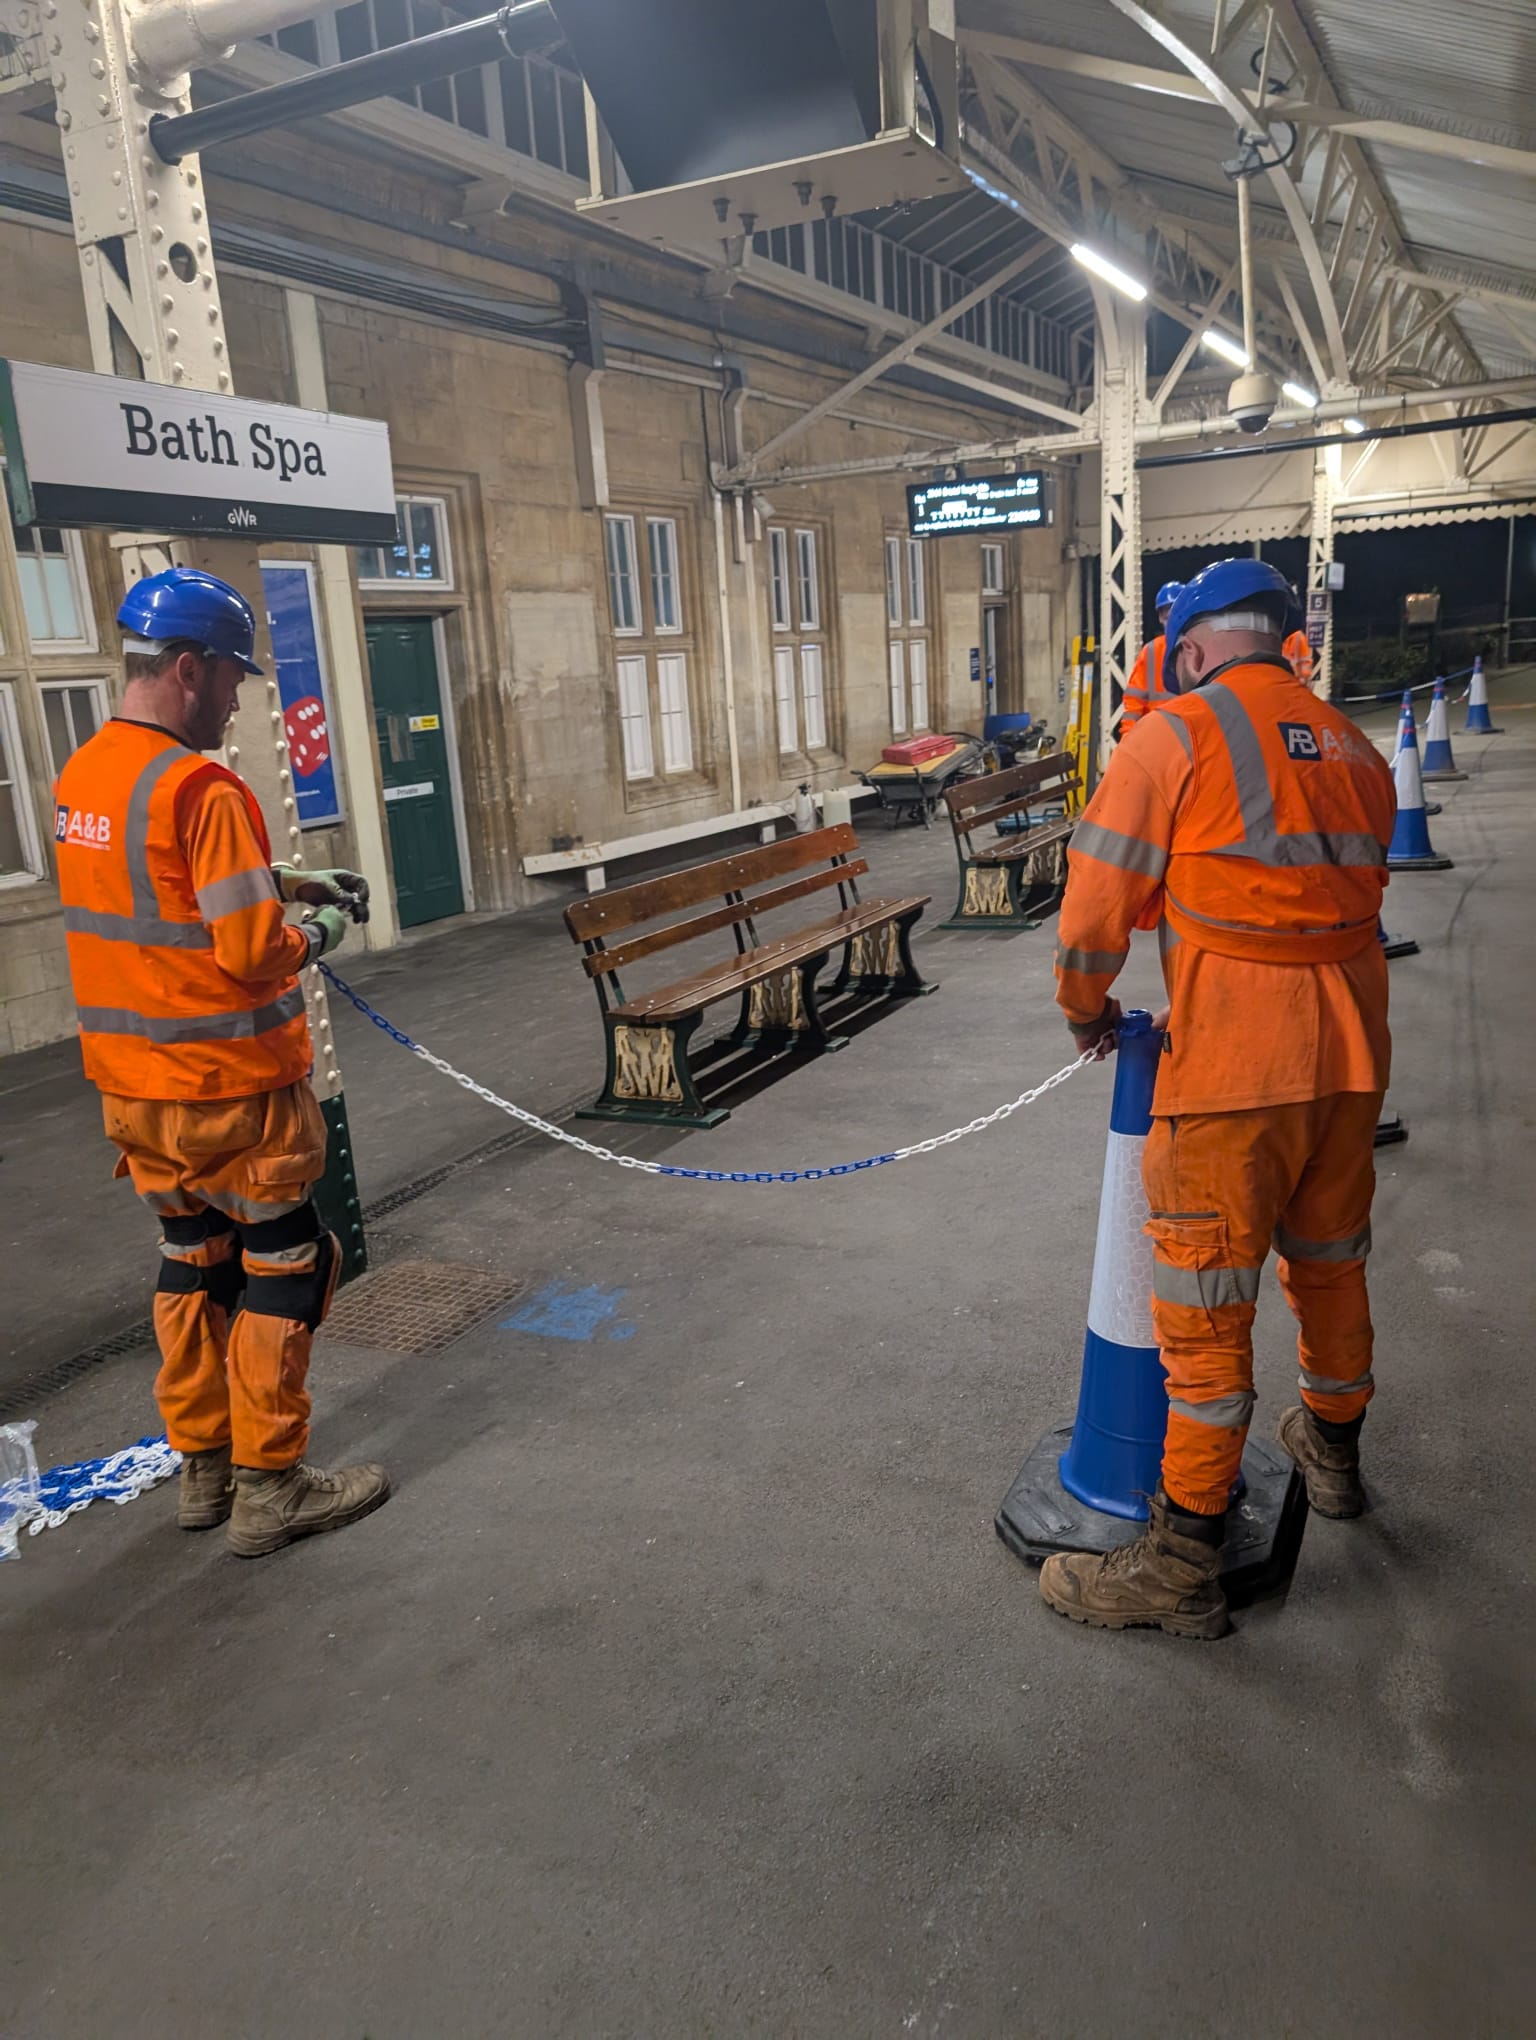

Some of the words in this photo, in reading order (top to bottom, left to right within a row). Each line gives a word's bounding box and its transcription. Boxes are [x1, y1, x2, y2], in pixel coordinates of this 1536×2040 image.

[119, 402, 239, 467] Bath
[250, 422, 327, 482] Spa
[228, 506, 258, 528] GWR
[67, 810, 111, 842] A&B
